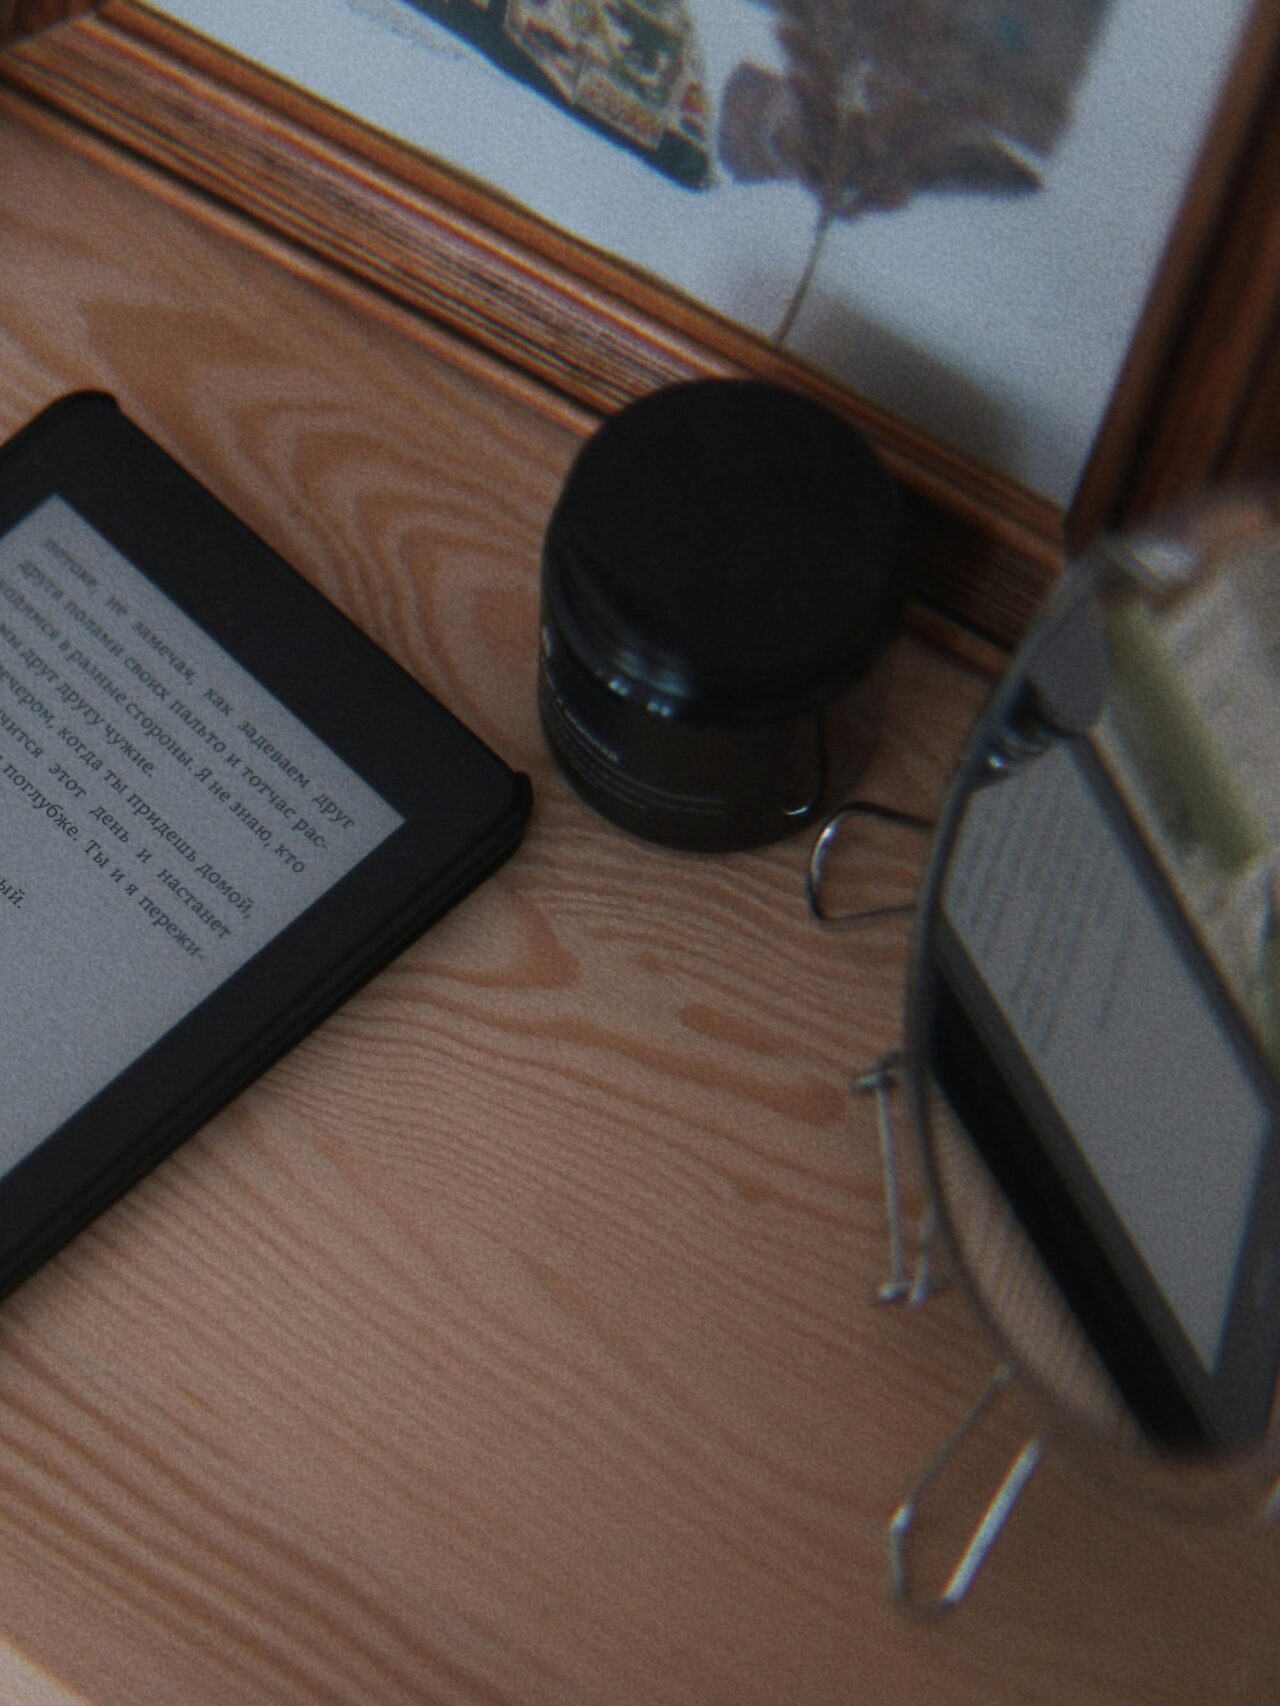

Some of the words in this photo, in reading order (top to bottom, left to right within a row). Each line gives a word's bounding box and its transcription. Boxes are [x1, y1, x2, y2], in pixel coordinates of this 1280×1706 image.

[18, 647, 60, 682] друг
[54, 681, 105, 726] другу
[104, 722, 155, 778] чужие.
[56, 637, 72, 652] в
[64, 648, 127, 704] разные
[124, 701, 194, 771] стороны.
[191, 765, 214, 784] Я
[205, 778, 232, 804] не
[227, 800, 273, 848] знаю,
[272, 842, 306, 873] кто
[62, 599, 125, 657] полами
[122, 656, 171, 701] своих
[167, 698, 227, 753] пальто
[222, 751, 243, 769] и
[240, 765, 297, 819] тотчас
[290, 816, 327, 849] рас-
[104, 594, 129, 617] не
[130, 620, 196, 685] замечая,
[202, 687, 234, 716] как
[236, 719, 310, 789] задеваем
[310, 792, 355, 829] друг
[1, 761, 79, 842] поглубже.
[81, 837, 112, 870] Ты
[107, 865, 127, 885] и
[122, 881, 140, 898] я
[136, 894, 204, 960] пережи-
[47, 762, 87, 799] этот
[87, 804, 129, 843] день
[133, 845, 154, 865] и
[155, 867, 231, 939] настанет
[56, 725, 104, 771] когда
[101, 767, 130, 796] ты
[124, 791, 197, 862] придешь
[193, 861, 255, 919] домой,
